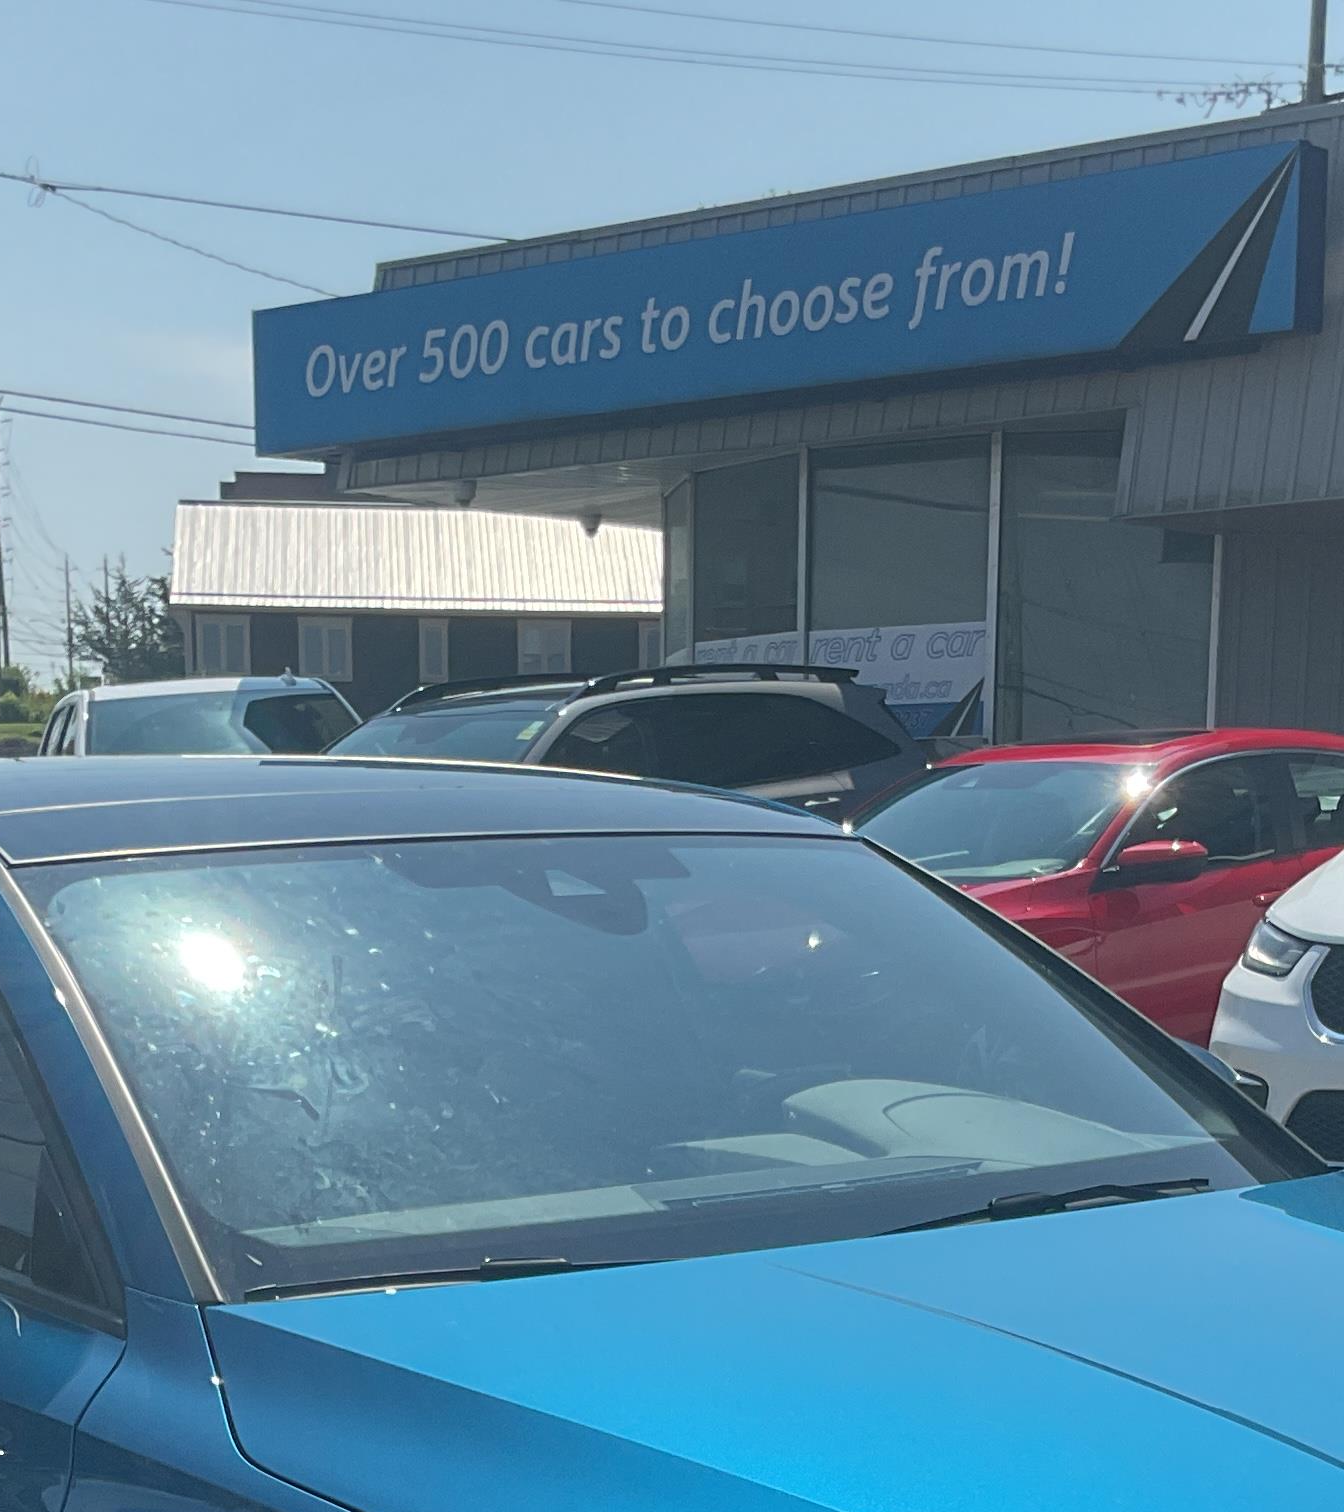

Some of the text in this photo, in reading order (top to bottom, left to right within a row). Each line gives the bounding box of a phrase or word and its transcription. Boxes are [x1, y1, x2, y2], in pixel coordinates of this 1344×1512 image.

[305, 230, 1076, 399] Over 500 cars to choose from!
[810, 627, 986, 665] rent a car
